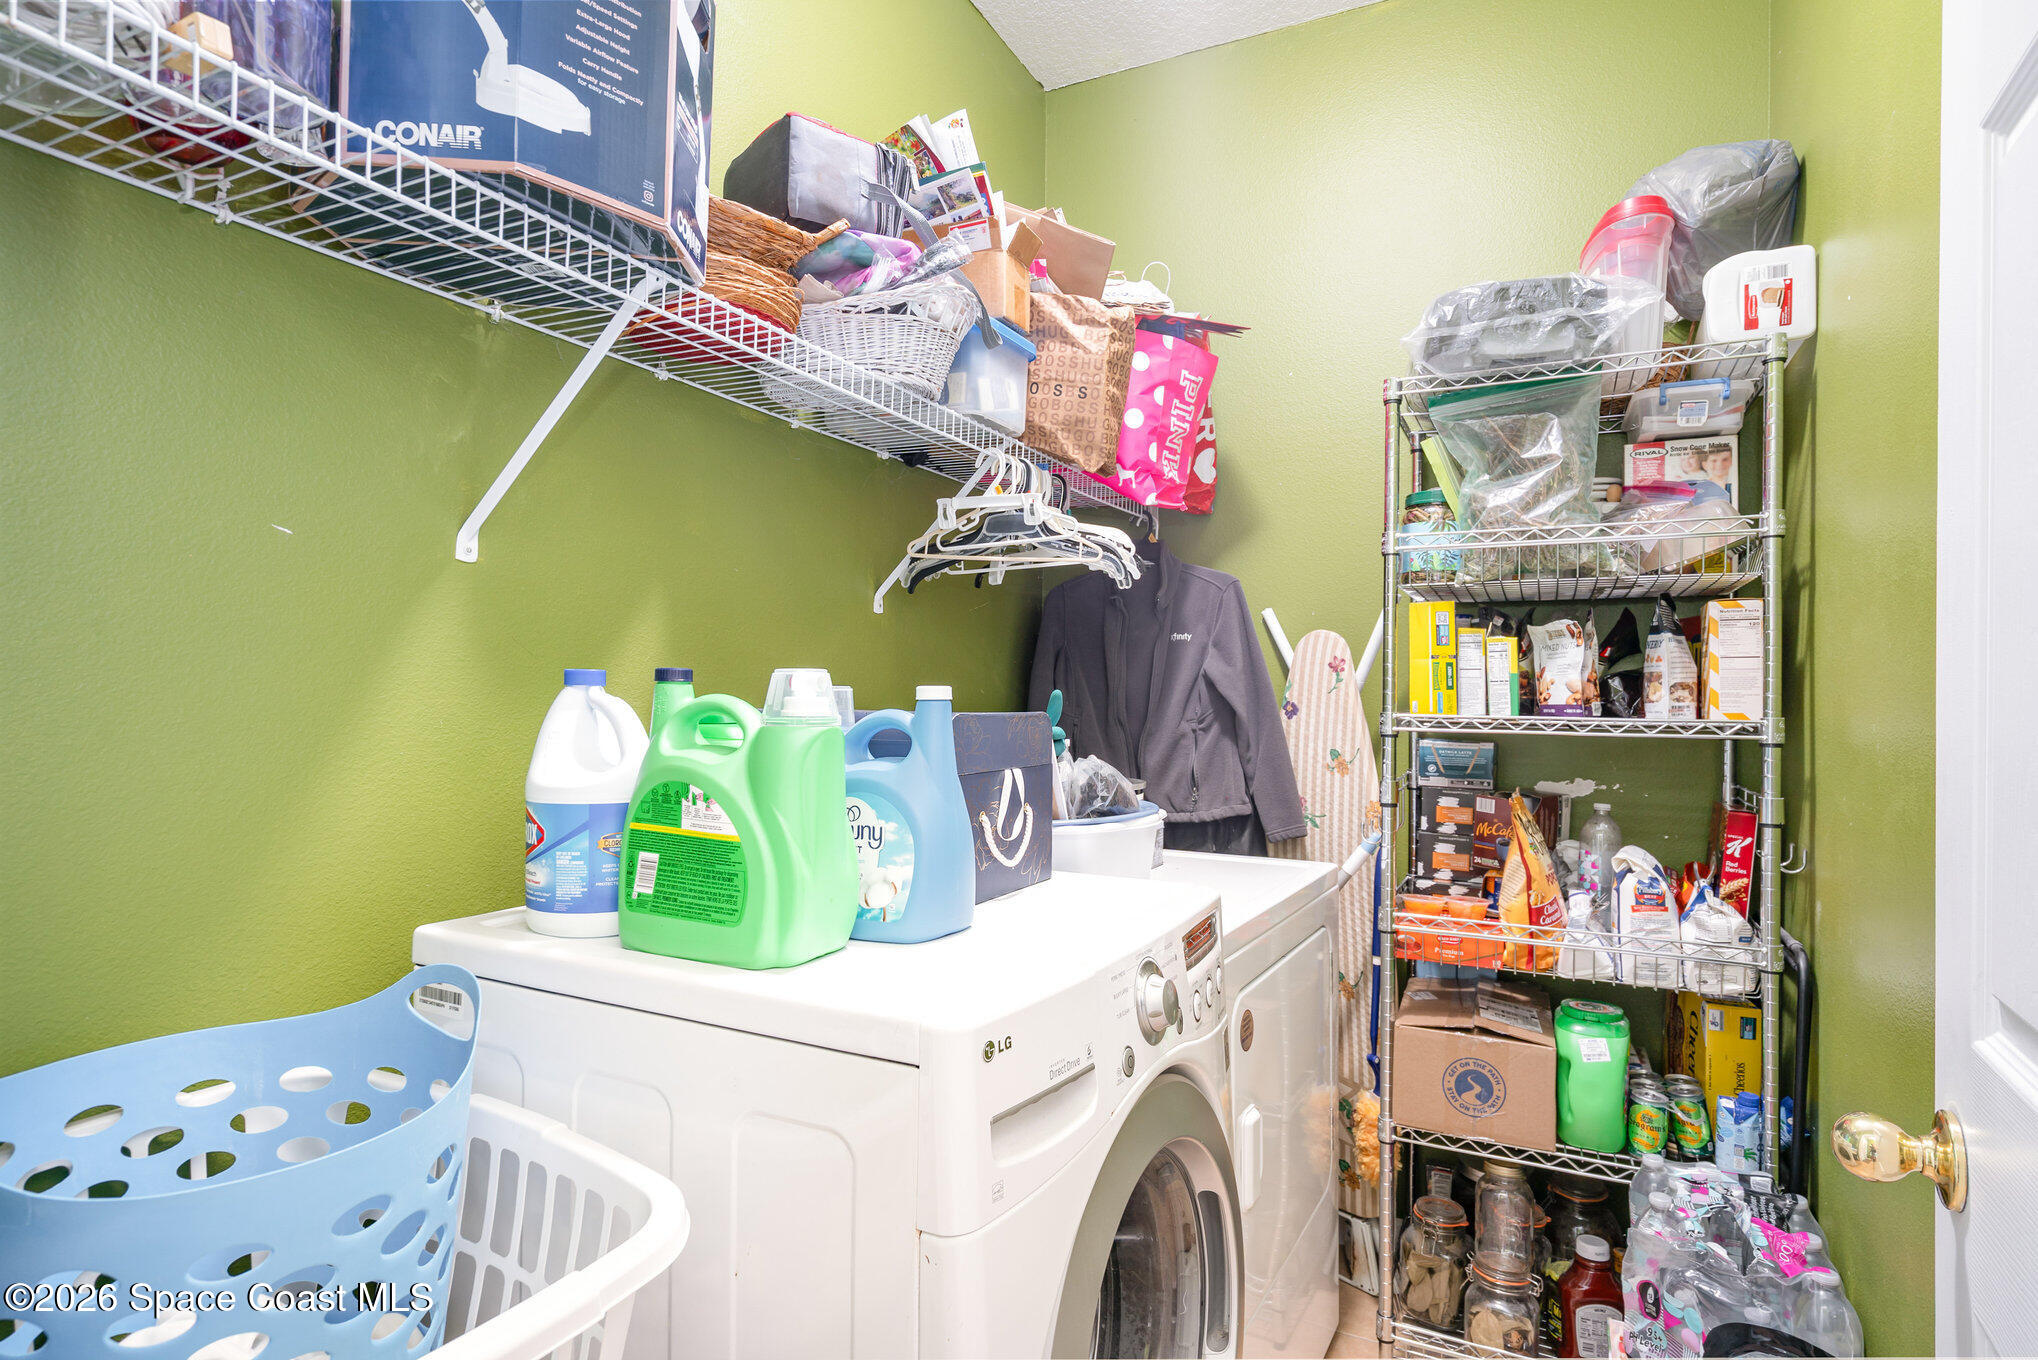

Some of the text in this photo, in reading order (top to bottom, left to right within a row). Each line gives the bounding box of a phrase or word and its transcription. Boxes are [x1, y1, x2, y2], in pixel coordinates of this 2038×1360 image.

[576, 8, 630, 40] Extra-Large Hood
[613, 12, 638, 30] Settings
[576, 24, 630, 55] Adjustable Height
[565, 33, 638, 74] Variable Airflow Feature
[582, 57, 622, 81] Carry Handle
[558, 61, 643, 106] Folds Neatly and Compactly
[577, 77, 625, 105] for easy storage
[375, 119, 482, 150] CONAIR
[1161, 368, 1205, 485] PINK
[1670, 445, 1688, 453] Snow
[1689, 443, 1707, 451] Cone
[1540, 641, 1577, 652] MIXED NUTS
[851, 825, 883, 850] wny
[1726, 836, 1753, 858] K
[1725, 860, 1738, 868] Red
[1725, 867, 1747, 875] Berries
[1434, 946, 1464, 956] Premium
[998, 1035, 1012, 1053] LG
[1049, 1057, 1081, 1080] Direct Drive
[1448, 1065, 1459, 1077] GET
[1472, 1061, 1487, 1070] THE
[1487, 1068, 1502, 1085] PATH
[1733, 1062, 1746, 1097] Cheerios
[1447, 1086, 1459, 1102] STAY
[1459, 1102, 1470, 1111] ON
